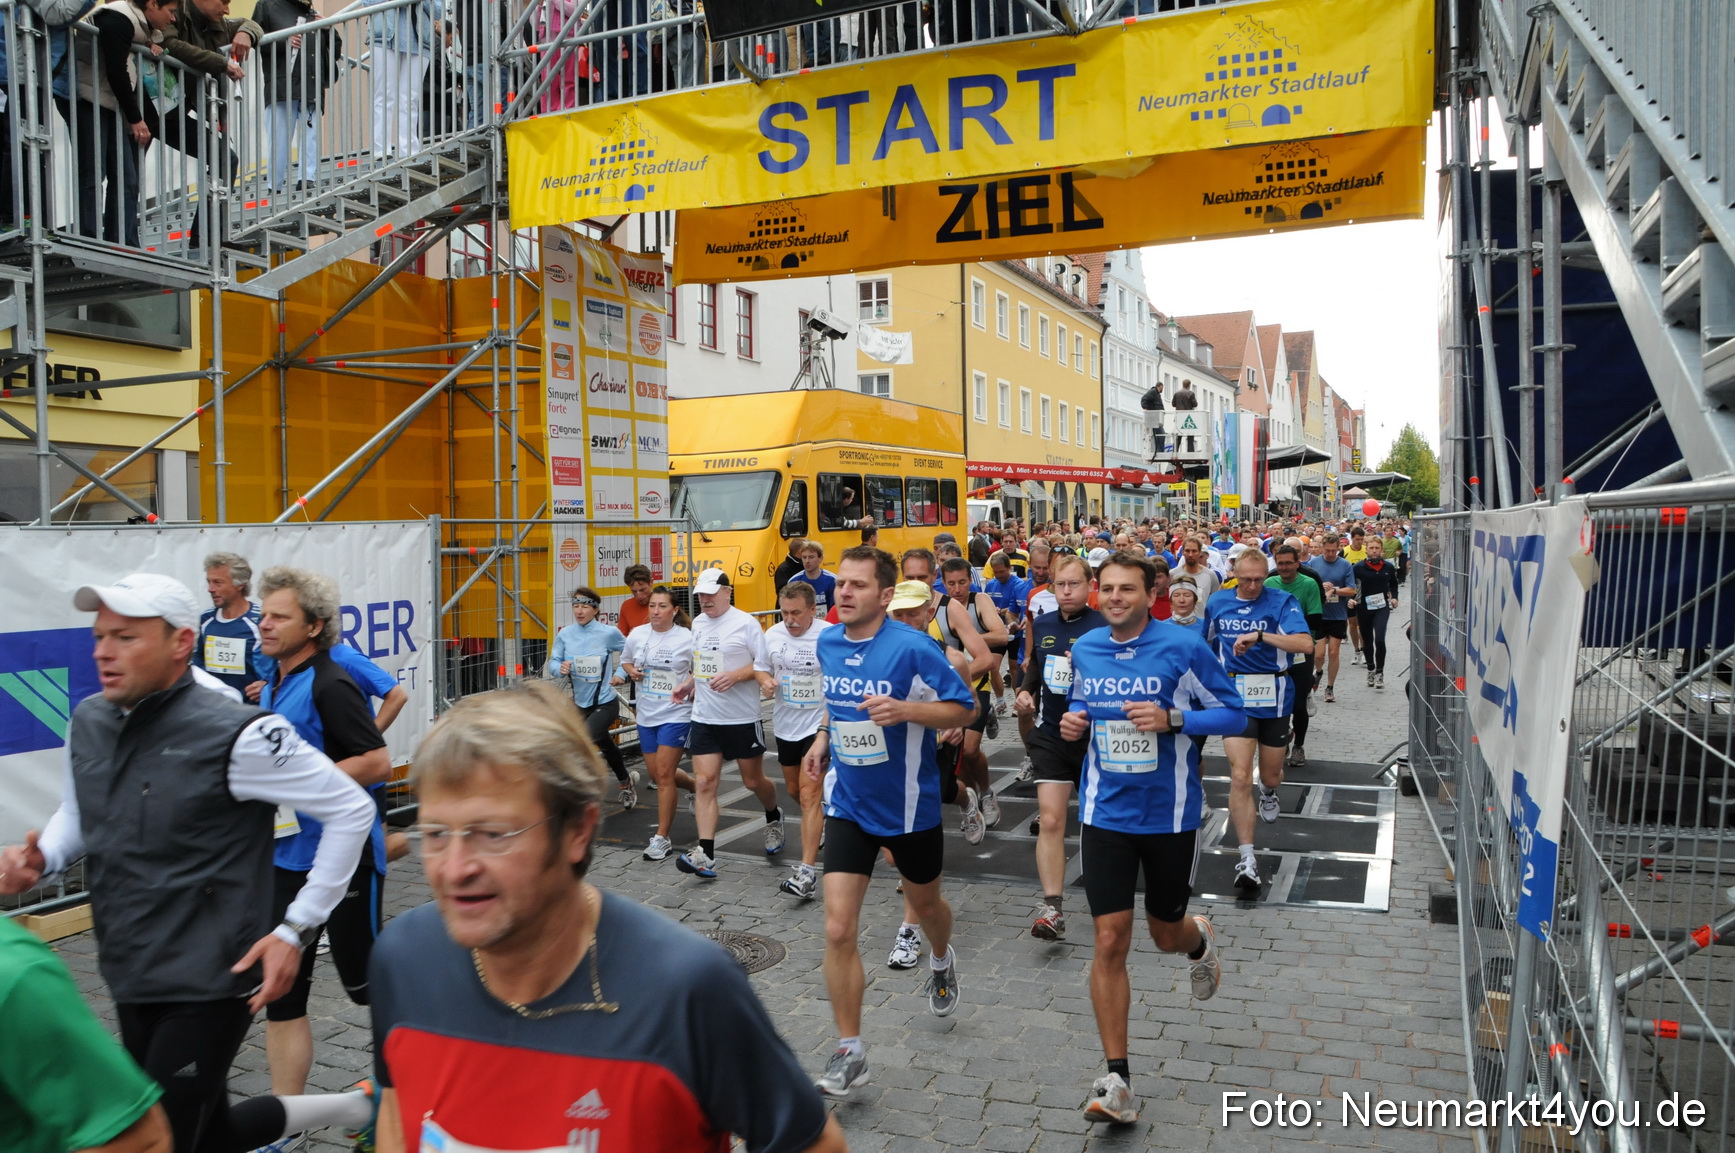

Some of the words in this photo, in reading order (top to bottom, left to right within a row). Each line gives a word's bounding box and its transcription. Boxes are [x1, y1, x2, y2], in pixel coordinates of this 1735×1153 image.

[1138, 82, 1263, 113] Neumarkter
[1268, 65, 1370, 96] Stadtlauf
[757, 62, 1076, 175] START
[541, 166, 628, 191] Neumarkter
[632, 155, 709, 177] Stadtlauf
[1203, 182, 1302, 206] Neumarkter
[1304, 171, 1384, 196] Stadtlauf
[935, 172, 1104, 243] ZIEL
[705, 236, 784, 256] Neumarkter
[786, 230, 849, 248] Stadtlauf
[624, 268, 665, 287] MERZ
[590, 372, 627, 394] Charivari
[548, 387, 578, 403] Sinupret
[548, 402, 567, 414] forte
[638, 436, 660, 451] MCM
[703, 457, 758, 469] TIMING
[839, 451, 868, 461] SPORTRONIC
[914, 458, 926, 468] EVENT
[927, 460, 944, 469] SERVICE
[1039, 468, 1072, 476] Serviceline:
[553, 507, 585, 515] HACKNER
[598, 546, 632, 564] Sinupret
[599, 564, 618, 578] forte
[1218, 619, 1268, 631] SYSCAD
[218, 651, 237, 662] 537
[577, 666, 597, 674] 3020
[701, 664, 718, 673] 305
[652, 681, 673, 690] 2520
[822, 675, 892, 697] SYSCAD
[1083, 676, 1162, 696] SYSCAD
[1248, 687, 1271, 696] 2977
[792, 689, 815, 698] 2521
[1110, 725, 1146, 736] Wolfgang
[842, 734, 877, 748] 3540
[1112, 739, 1151, 753] 2052
